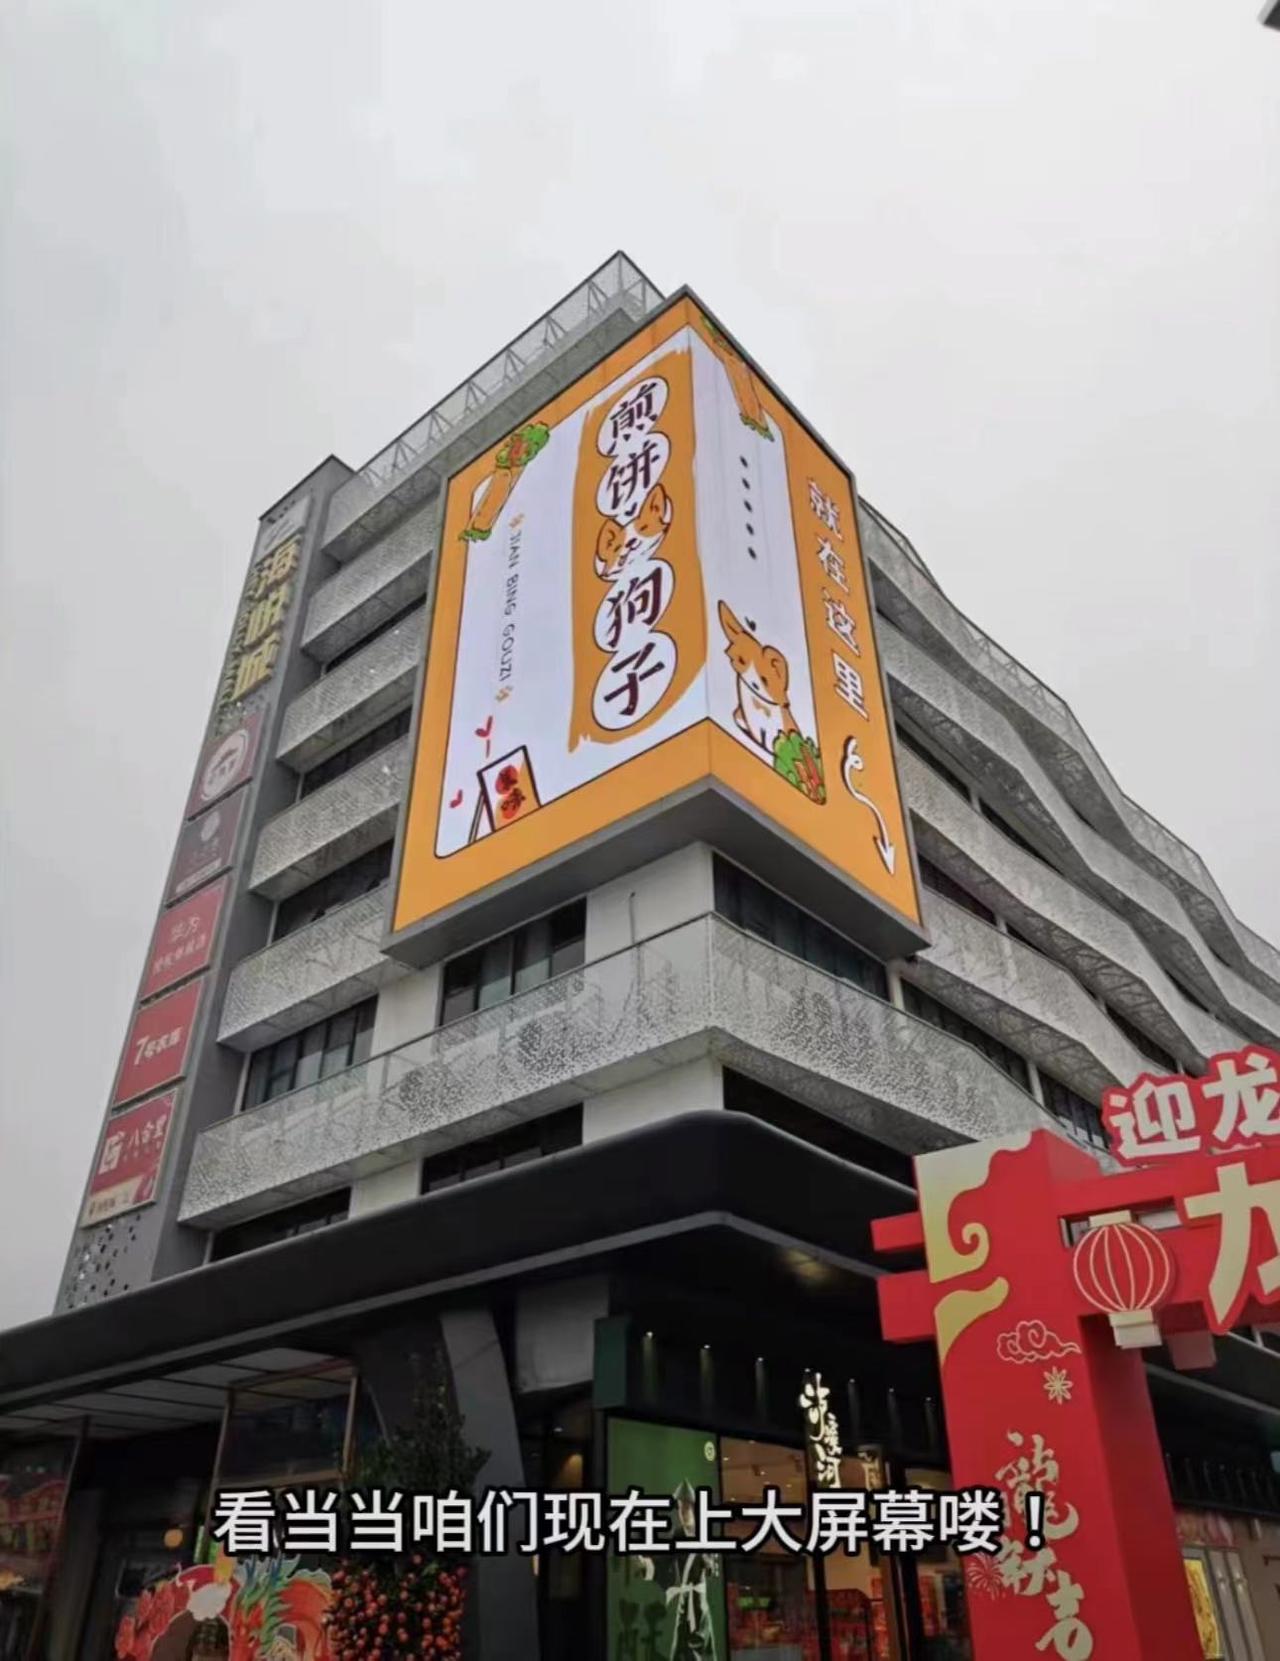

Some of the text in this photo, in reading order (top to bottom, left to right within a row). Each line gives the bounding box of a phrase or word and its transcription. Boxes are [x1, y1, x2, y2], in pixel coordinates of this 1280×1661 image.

[504, 573, 519, 616] BING
[603, 381, 666, 717] 煎饼狗子
[808, 477, 869, 720] 就在这里
[499, 623, 516, 682] GOUZI
